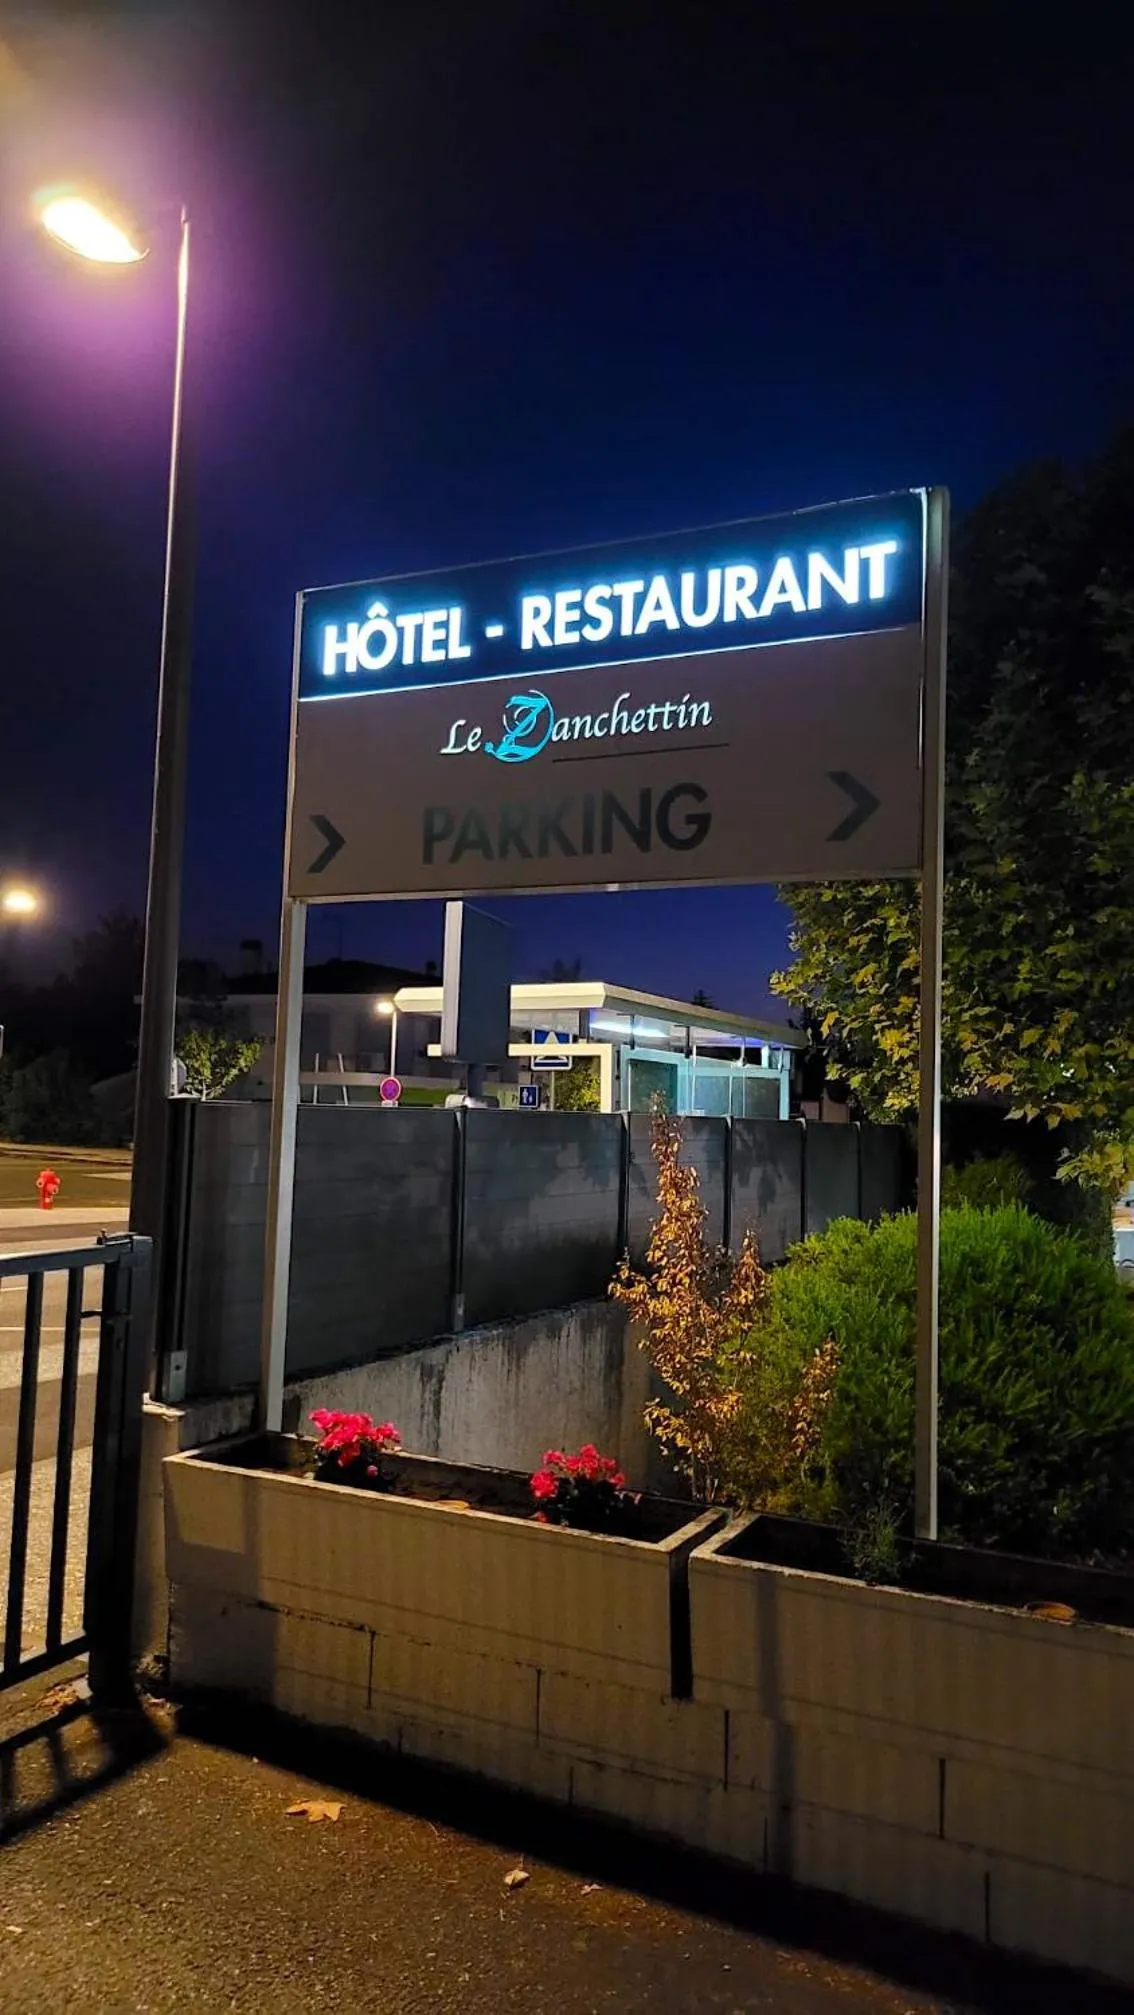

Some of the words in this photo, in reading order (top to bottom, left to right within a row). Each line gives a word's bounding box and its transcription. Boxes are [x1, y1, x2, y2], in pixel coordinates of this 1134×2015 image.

[322, 601, 471, 676] HÔTEL
[520, 541, 898, 650] RESTAURANT
[440, 719, 482, 755] Le
[484, 690, 713, 763] Zanchettin
[421, 781, 713, 865] PARKING
